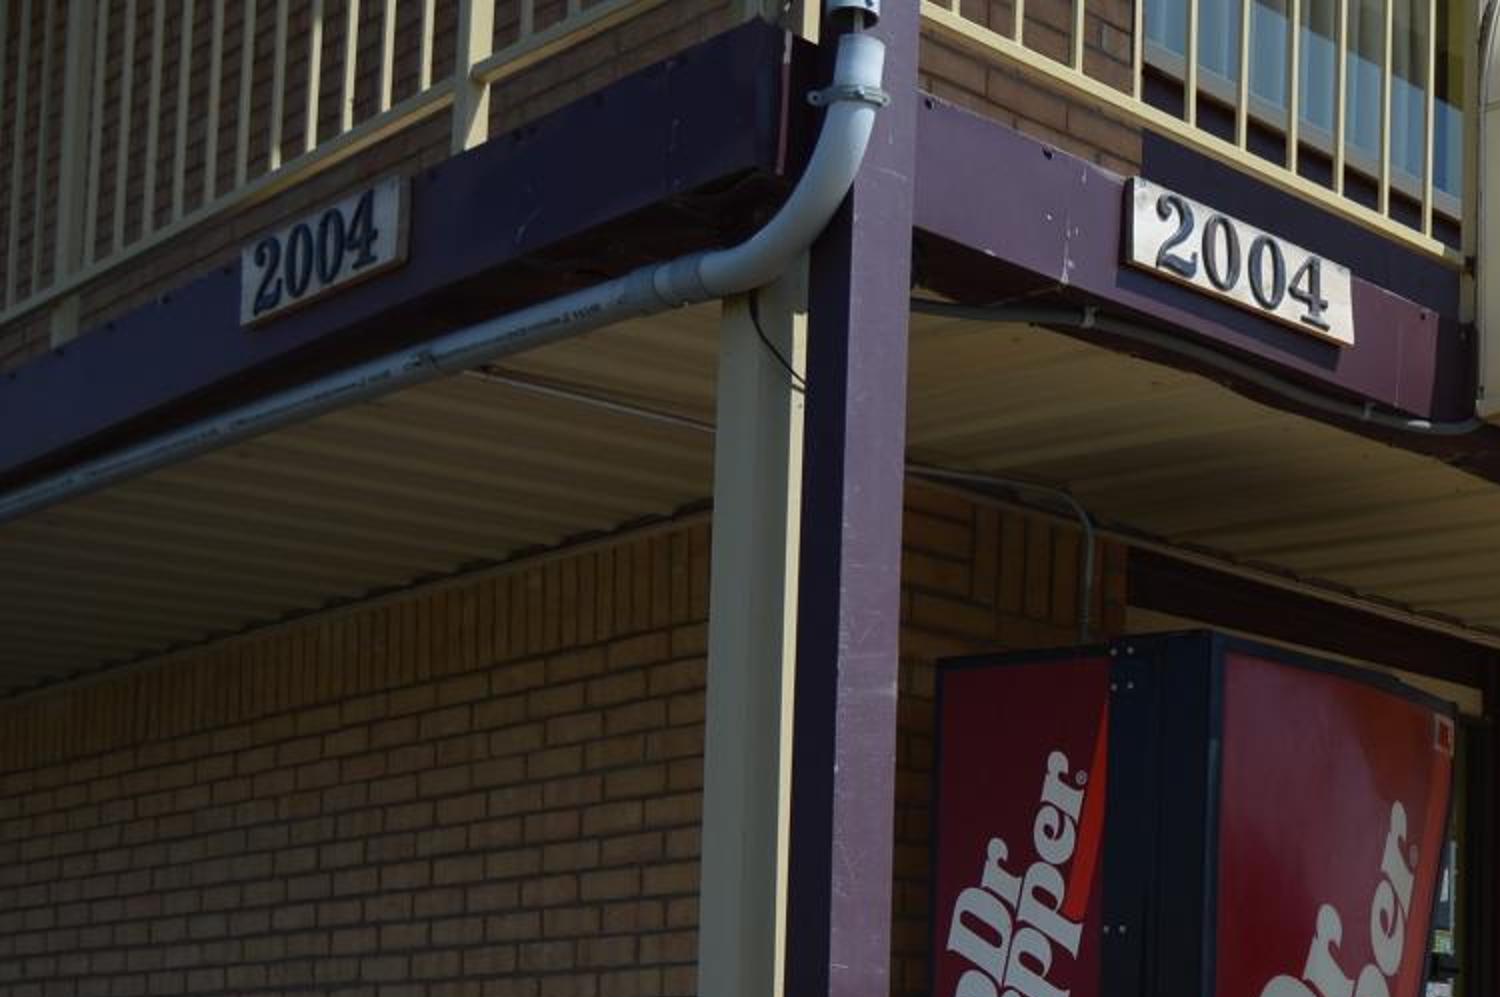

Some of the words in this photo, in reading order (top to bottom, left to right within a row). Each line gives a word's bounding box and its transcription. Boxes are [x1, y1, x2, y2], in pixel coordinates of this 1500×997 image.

[254, 188, 378, 316] 2004
[1156, 194, 1331, 332] 2004
[947, 837, 1024, 987] Dr
